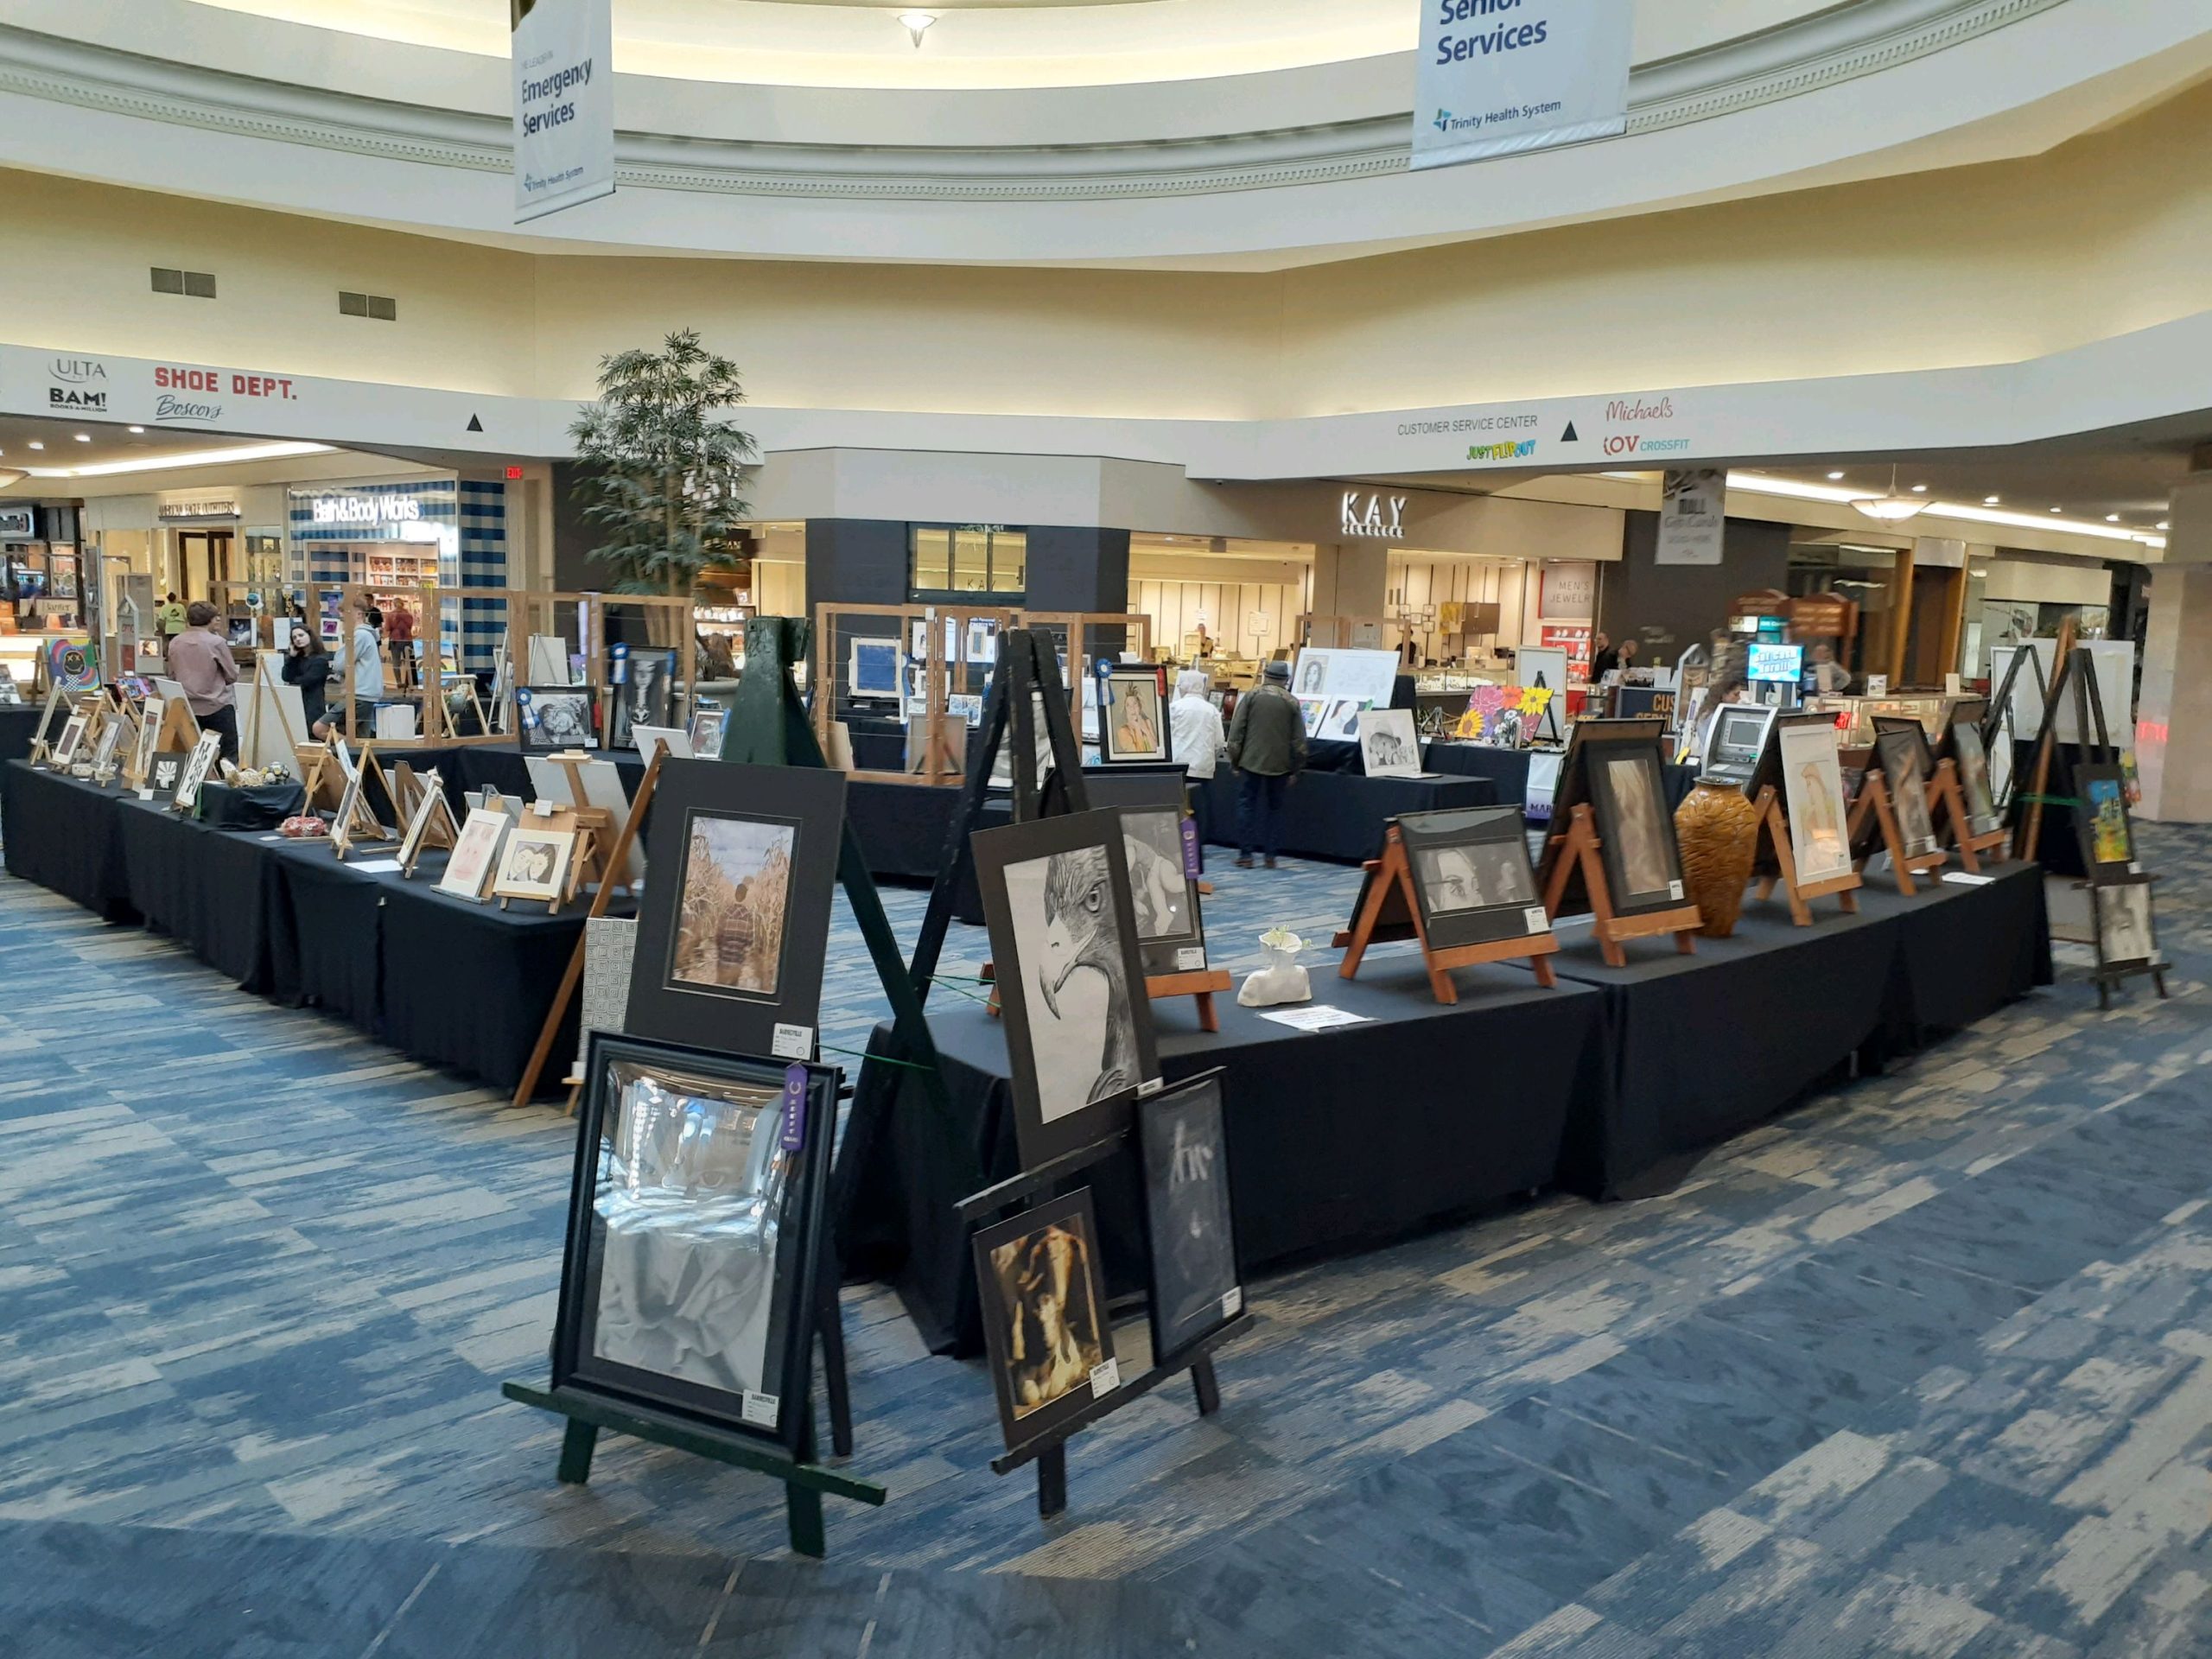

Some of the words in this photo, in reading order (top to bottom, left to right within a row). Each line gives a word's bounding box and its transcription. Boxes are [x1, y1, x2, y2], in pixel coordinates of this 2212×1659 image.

[1436, 20, 1548, 66] Services
[522, 58, 592, 105] Emergency
[523, 102, 575, 137] Services
[1452, 117, 1482, 130] Trinity
[1485, 107, 1519, 124] Health
[1522, 101, 1561, 119] System
[57, 359, 106, 378] ULTA
[155, 366, 219, 392] SHOE
[232, 374, 297, 400] DEPT.
[49, 387, 106, 407] BAM!
[1605, 397, 1674, 422] Michaels
[1397, 421, 1450, 435] CUSTOMER
[1452, 417, 1494, 432] SERVICE
[1497, 415, 1538, 429] CENTER
[1640, 439, 1690, 451] CROSSFIT
[313, 499, 339, 522] Bath
[349, 497, 378, 526] Body
[379, 494, 420, 521] Works
[1342, 492, 1408, 526] KAY
[1549, 593, 1592, 603] JEWELR
[1559, 581, 1590, 591] MEN'S
